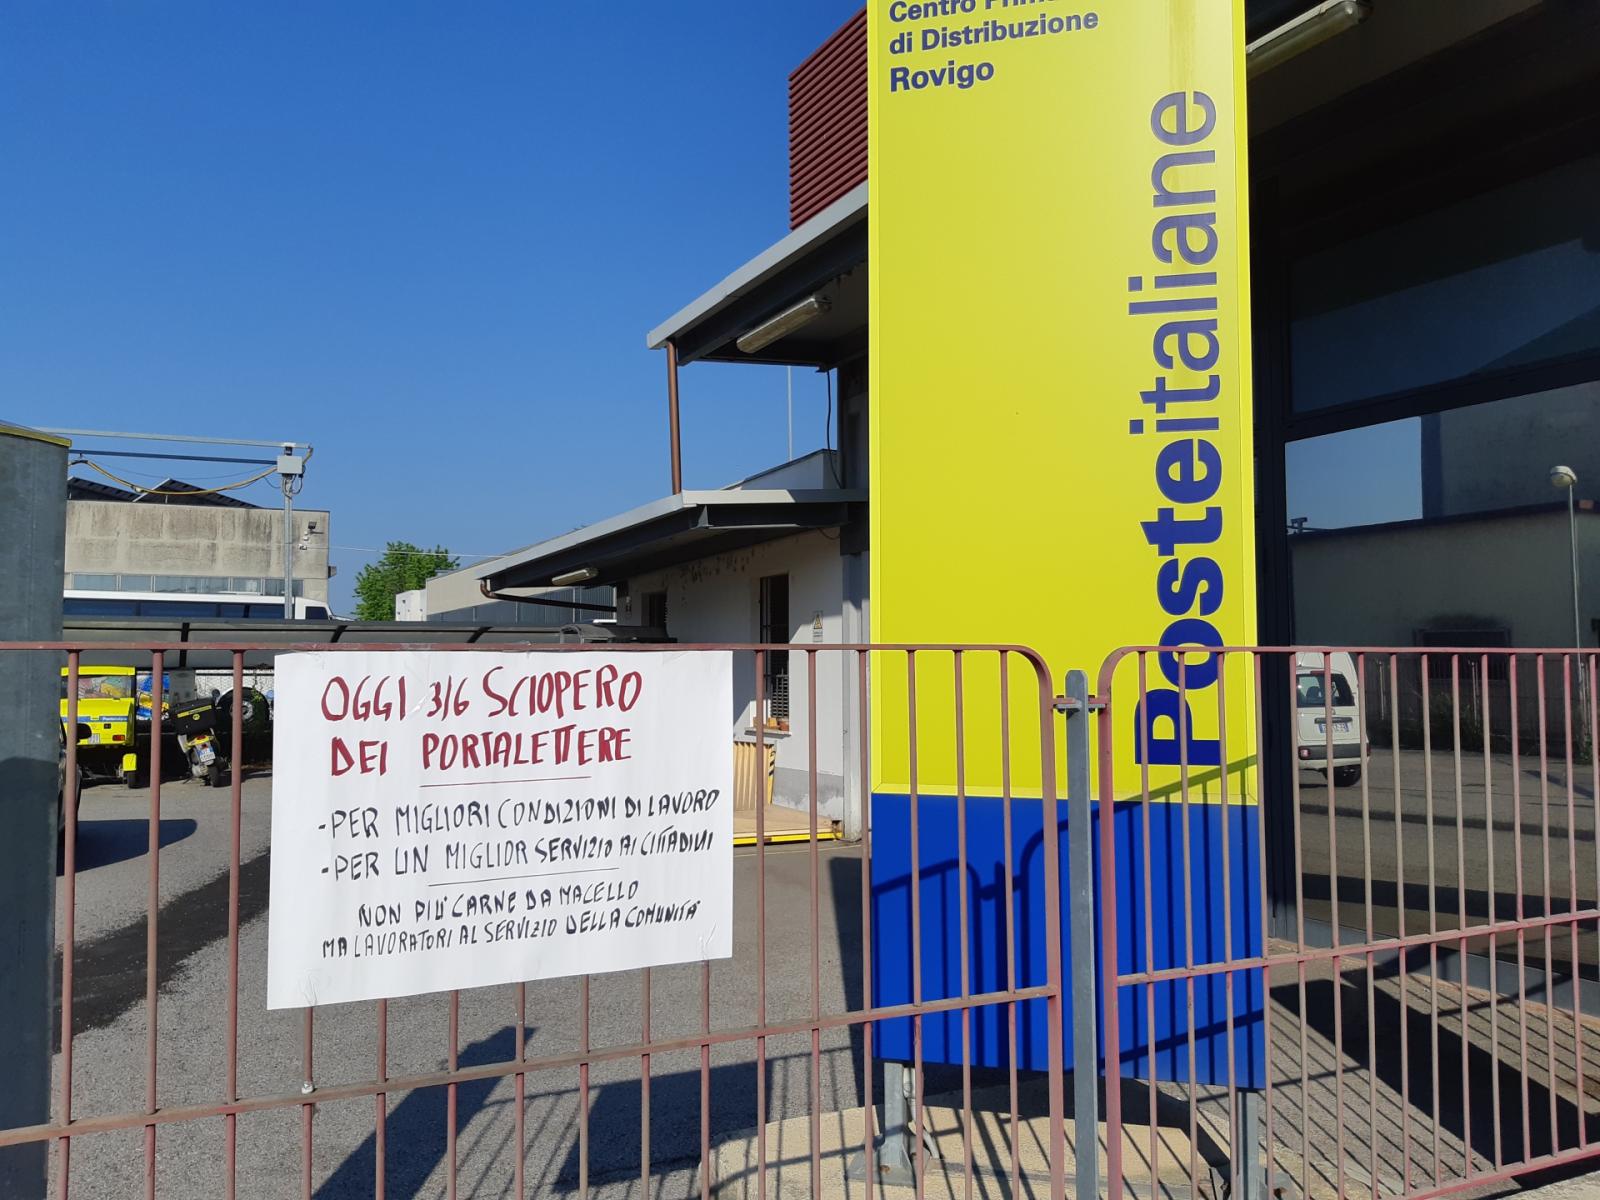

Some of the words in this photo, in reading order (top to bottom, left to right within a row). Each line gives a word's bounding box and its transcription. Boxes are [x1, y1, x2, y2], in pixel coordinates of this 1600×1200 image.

[889, 0, 976, 23] Centro
[889, 31, 912, 55] di
[921, 12, 1099, 51] Distribuzione
[890, 60, 995, 93] Rovigo
[1127, 90, 1226, 766] Posteitaliane
[321, 674, 406, 722] OGGI
[426, 674, 470, 722] 3/6
[482, 663, 643, 720] SCIOPERO
[330, 735, 388, 777] DEI
[421, 723, 633, 771] PORTALETTERE
[395, 800, 490, 836] MIGLIORI
[497, 795, 616, 829] CONDIZIONI
[624, 795, 642, 819] DI
[647, 788, 721, 818] LAVORO
[394, 843, 429, 876] UN
[445, 839, 529, 870] MIGLIOR
[534, 833, 614, 864] SERVIZIO
[619, 834, 637, 857] AI
[640, 824, 714, 857] CITTADINI
[358, 902, 401, 928] NON
[451, 889, 517, 918] CARNE
[525, 888, 552, 911] DA
[558, 879, 640, 906] MACELLO
[322, 936, 348, 959] MA
[354, 927, 453, 958] LAVORATORI
[459, 924, 478, 945] AL
[483, 915, 558, 944] SERVIZIO
[565, 907, 621, 935] DELLA
